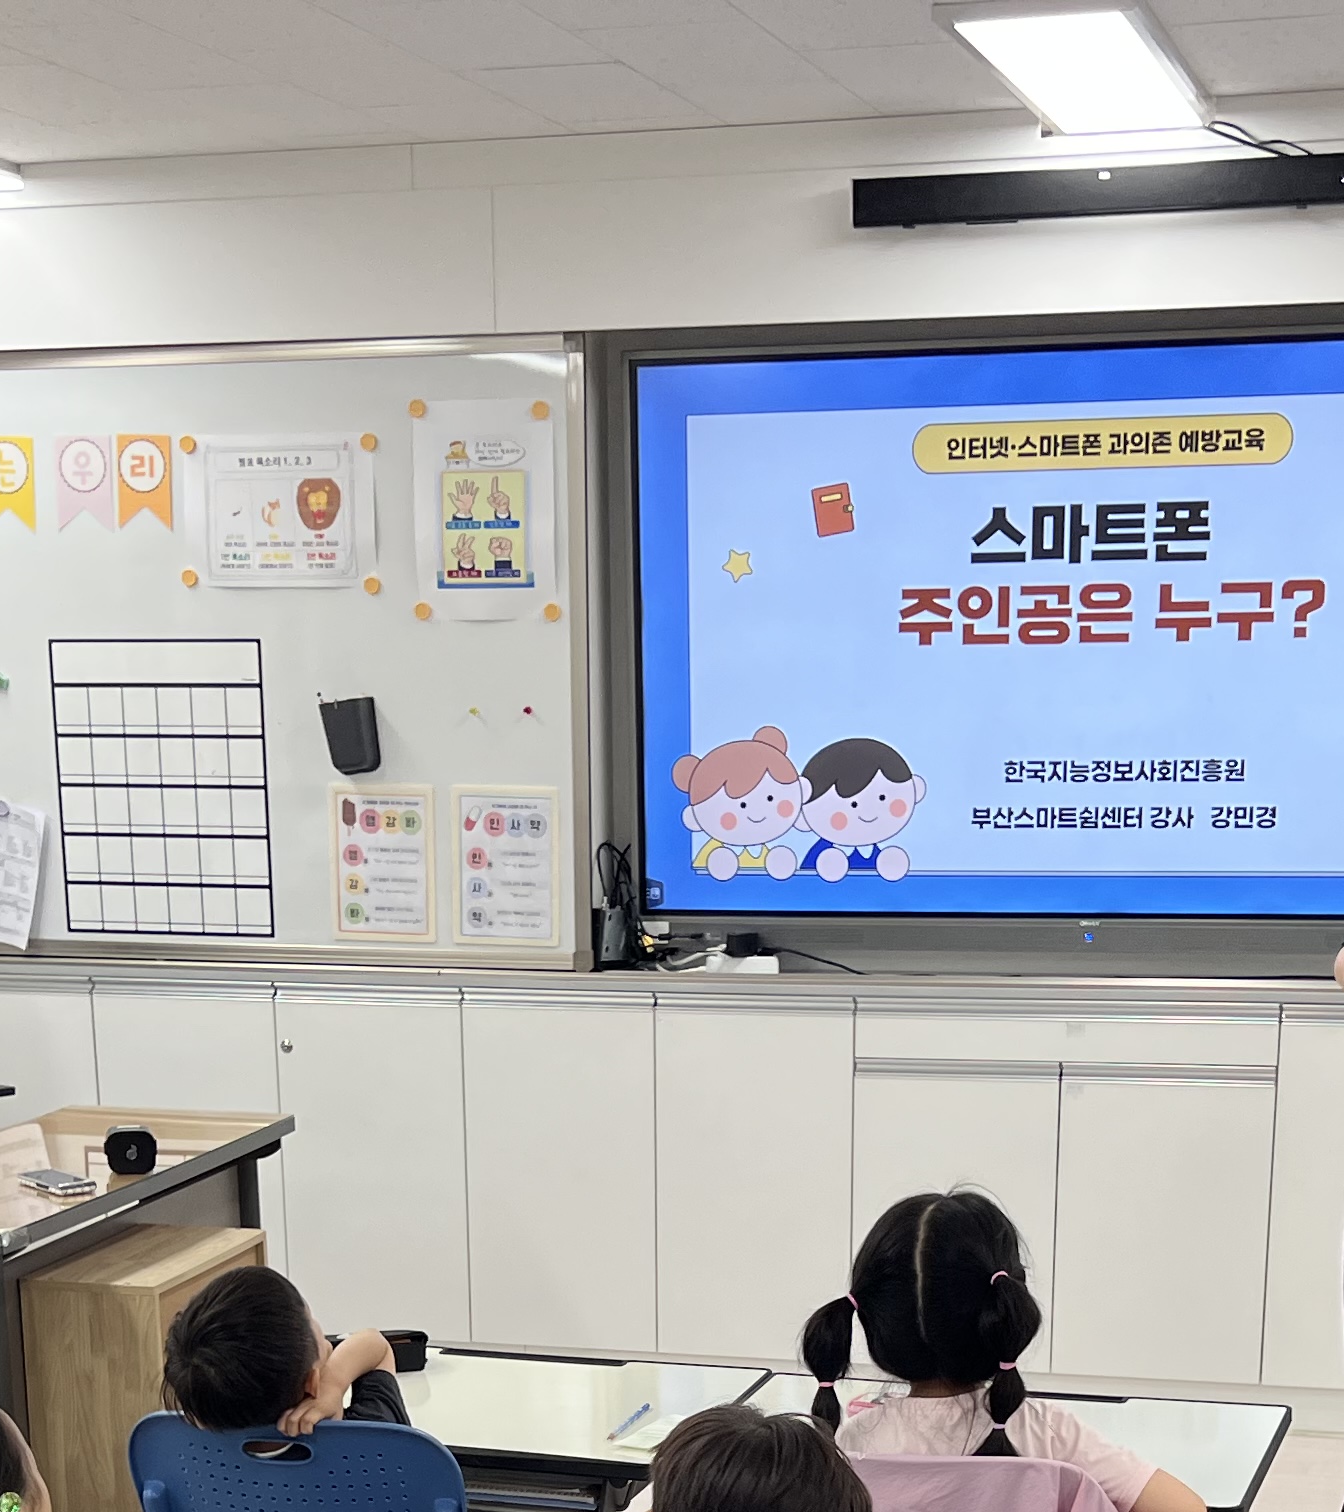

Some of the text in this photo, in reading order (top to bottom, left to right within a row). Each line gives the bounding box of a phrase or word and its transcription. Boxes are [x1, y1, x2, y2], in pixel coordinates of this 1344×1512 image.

[946, 427, 1266, 460] 인터넷·스마트폰 과의존 예방교육
[969, 500, 1212, 564] 스마트폰
[898, 578, 1326, 646] 주인공은 누구?
[1004, 758, 1246, 783] 한국지능정보사회진흥원
[971, 806, 1277, 829] 부산스마트쉼센터 강사 강민경
